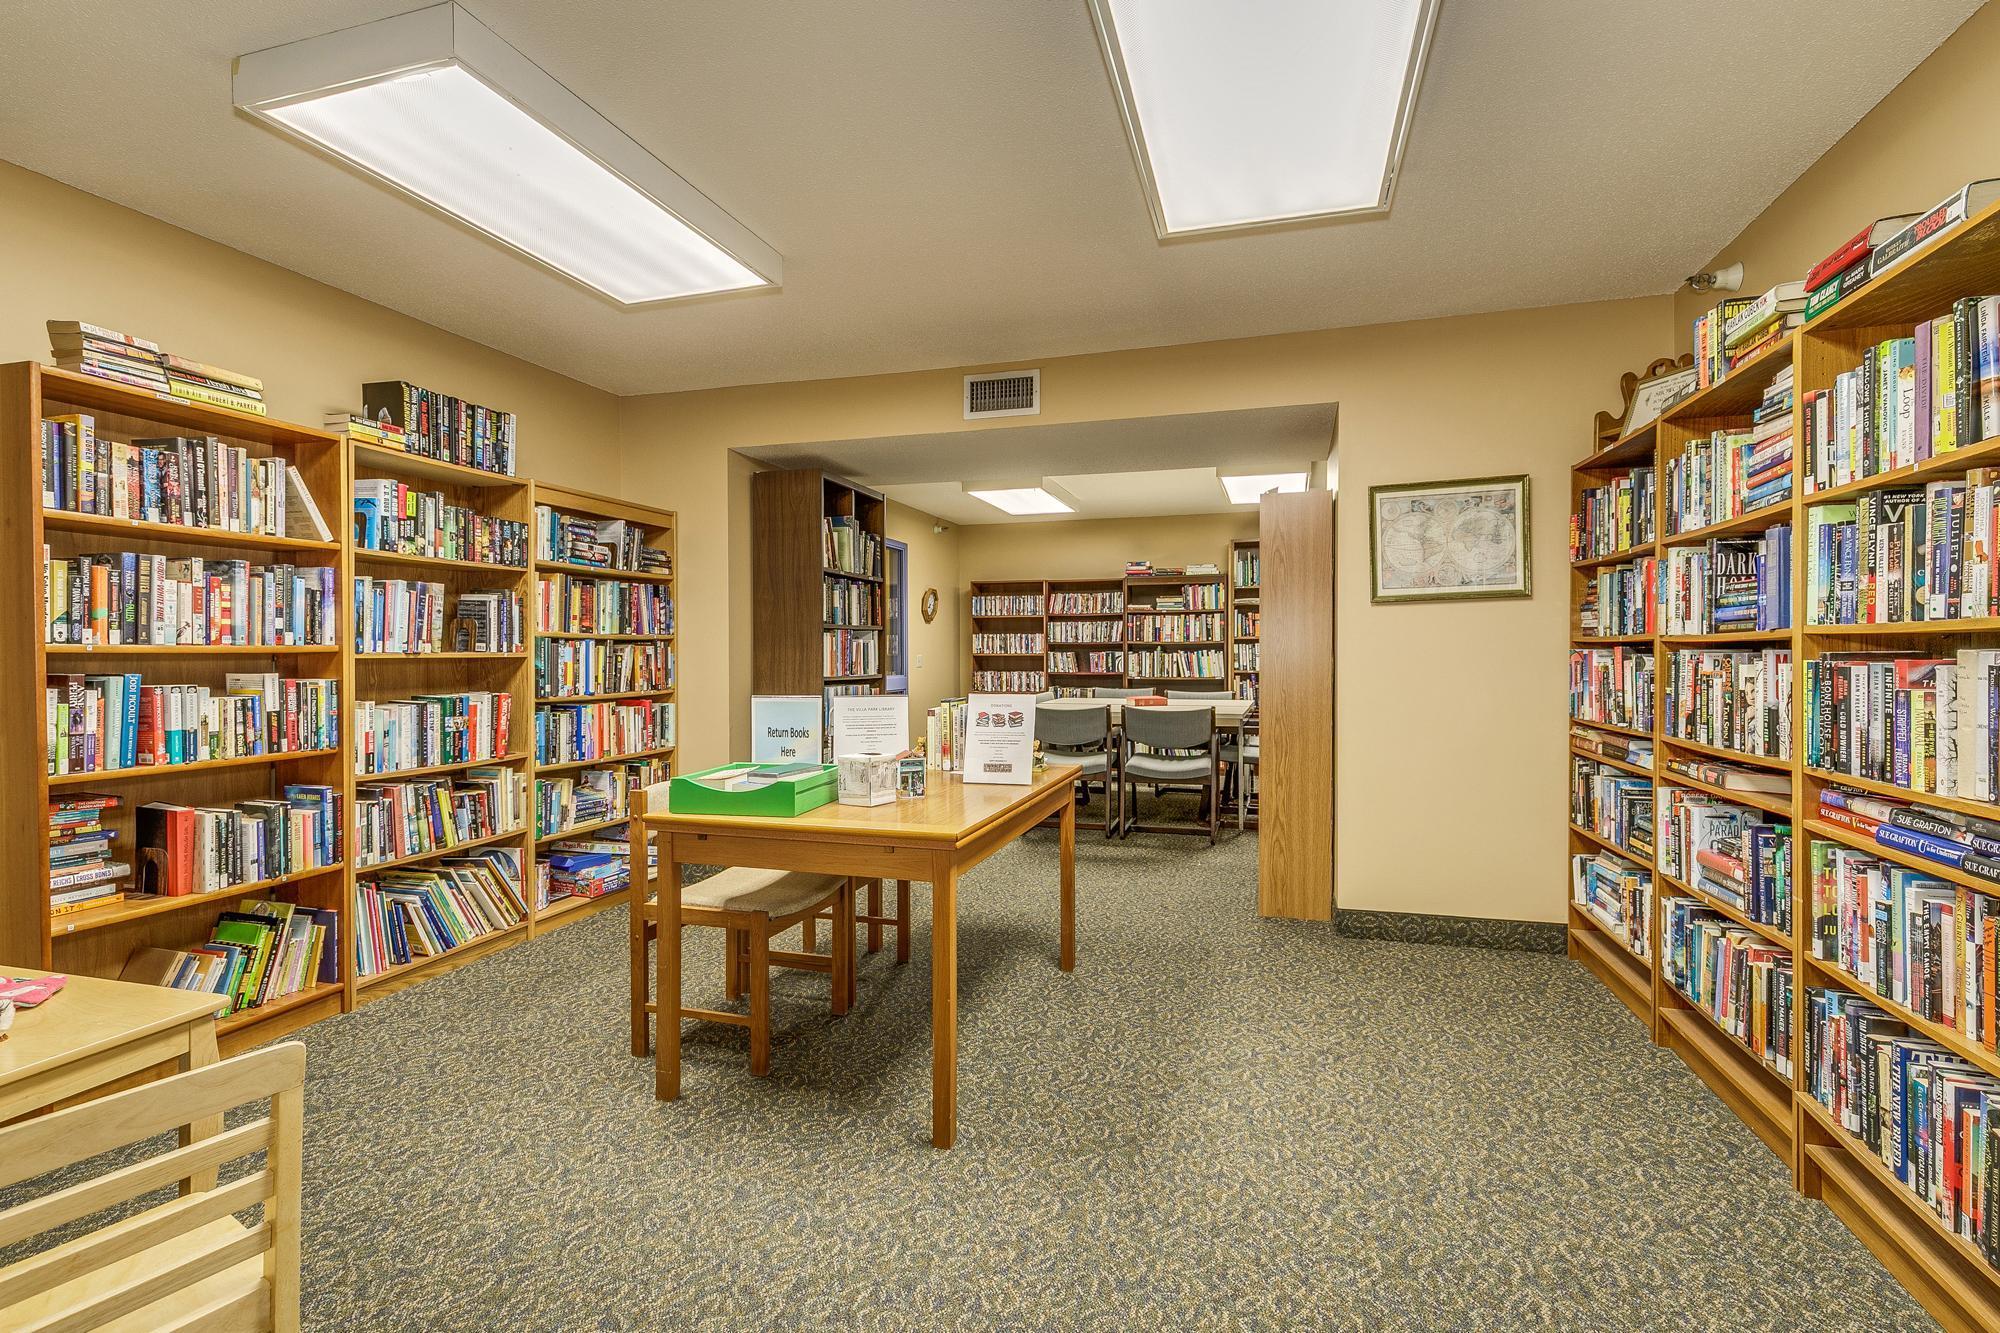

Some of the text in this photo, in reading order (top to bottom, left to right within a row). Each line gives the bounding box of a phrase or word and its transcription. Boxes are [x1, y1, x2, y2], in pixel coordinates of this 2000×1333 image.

[1916, 217, 1946, 241] BLOOD
[1980, 305, 1989, 364] LINDA FAIRSTEIN
[236, 400, 258, 412] PARKER
[1899, 388, 1913, 419] Loop
[1982, 400, 1990, 421] KILLS
[420, 413, 428, 435] Sandford
[1907, 492, 1925, 500] YORK
[1932, 516, 1947, 545] KNIGHTS
[1950, 512, 1961, 560] JULIET
[1868, 533, 1876, 567] FLYNN
[157, 561, 165, 583] ROOM
[1717, 552, 1757, 575] DARK
[157, 584, 165, 605] WHITE
[126, 603, 134, 622] FALLEN
[69, 682, 78, 709] PERRY
[129, 676, 138, 692] JODI
[1824, 680, 1832, 706] BONE
[77, 685, 85, 709] ANNE
[127, 694, 137, 724] PICOULT
[767, 727, 810, 738] Return Books
[1824, 707, 1832, 739] HOUSE
[1896, 709, 1907, 741] STRIPPED
[1915, 708, 1924, 748] IMMORAL
[1839, 711, 1847, 763] COLD NOWHERE
[780, 746, 796, 757] Here
[1895, 748, 1903, 778] FREEMAN
[1820, 808, 1852, 824] SUE GRAFTON
[1896, 814, 1953, 836] SUE GRAFTON
[1878, 829, 1919, 848] SUE GRAFTON
[1972, 838, 1986, 851] SUE
[53, 870, 112, 887] REICHS CROSS BONES
[1964, 861, 1978, 873] SUE
[1956, 913, 1964, 958] GERRITSEN
[1778, 976, 1786, 1005] SHROUD
[1778, 1006, 1786, 1032] MAKER
[1859, 1019, 1867, 1032] TIM
[1892, 1064, 1901, 1167] THE NEW BREED
[1935, 1077, 1943, 1143] JAMES GRIPPANDO
[1918, 1146, 1926, 1195] OUTCAST DEAD
